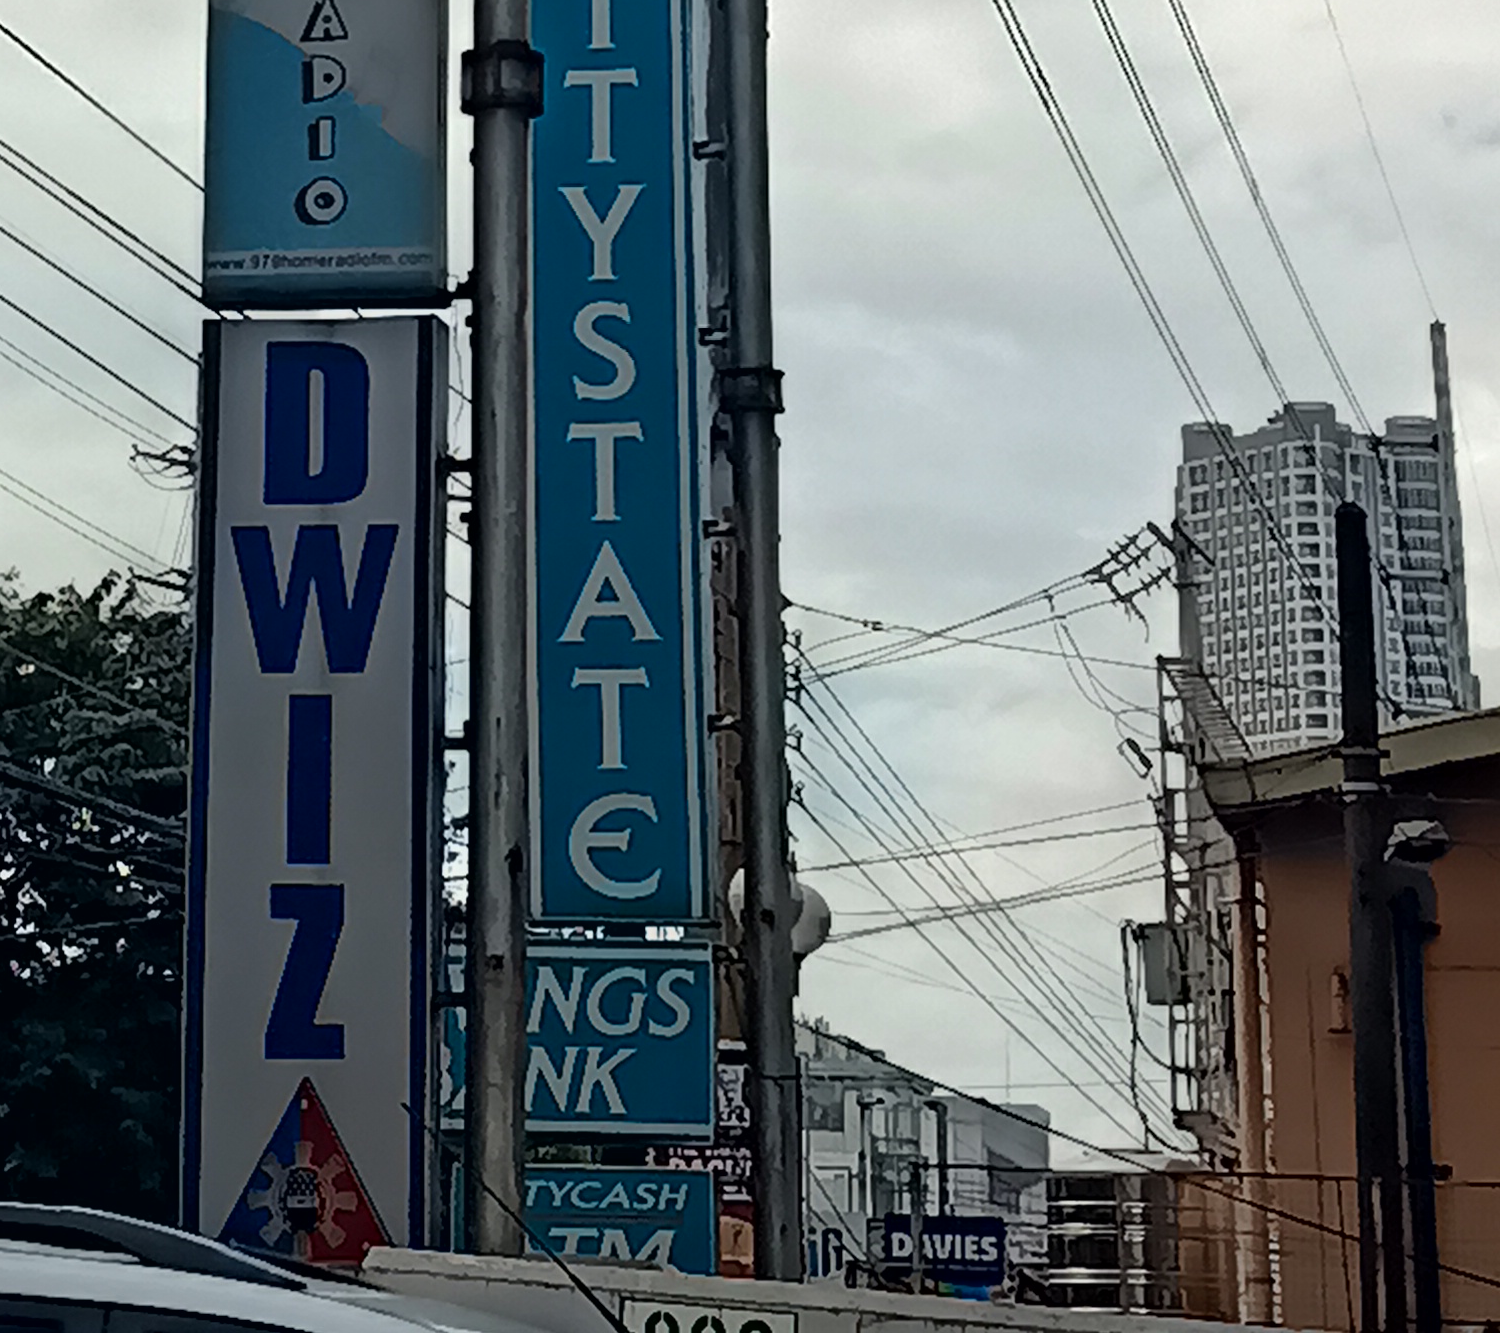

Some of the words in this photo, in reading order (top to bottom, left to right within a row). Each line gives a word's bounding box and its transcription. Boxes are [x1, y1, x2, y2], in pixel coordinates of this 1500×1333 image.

[230, 341, 399, 1059] DWIZ
[525, 965, 695, 1037] NGS
[524, 1045, 638, 1115] NK
[525, 1179, 689, 1211] TYCASH
[540, 1227, 676, 1268] TM
